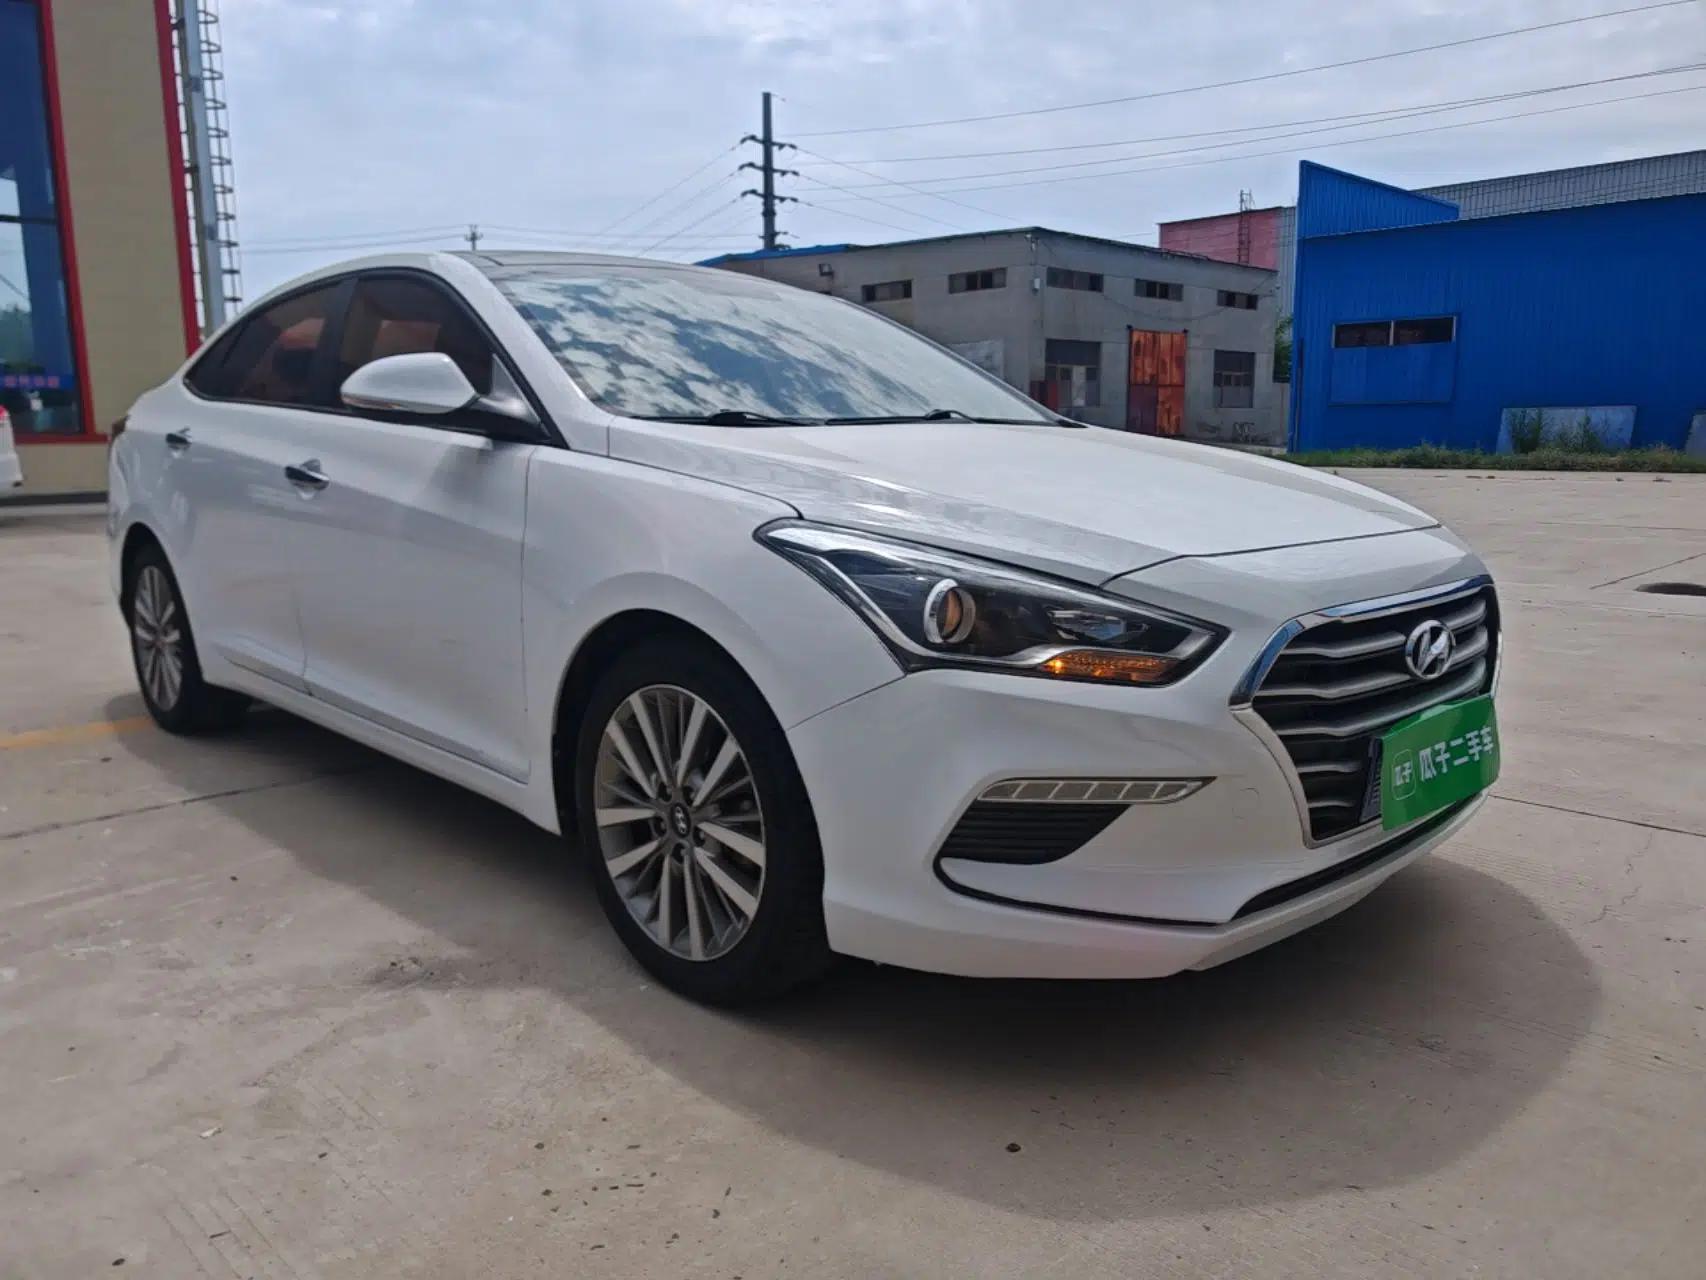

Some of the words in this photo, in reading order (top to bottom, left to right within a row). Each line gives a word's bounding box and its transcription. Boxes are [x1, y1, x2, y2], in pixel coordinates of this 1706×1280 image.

[1419, 726, 1494, 781] 瓜子二手车
